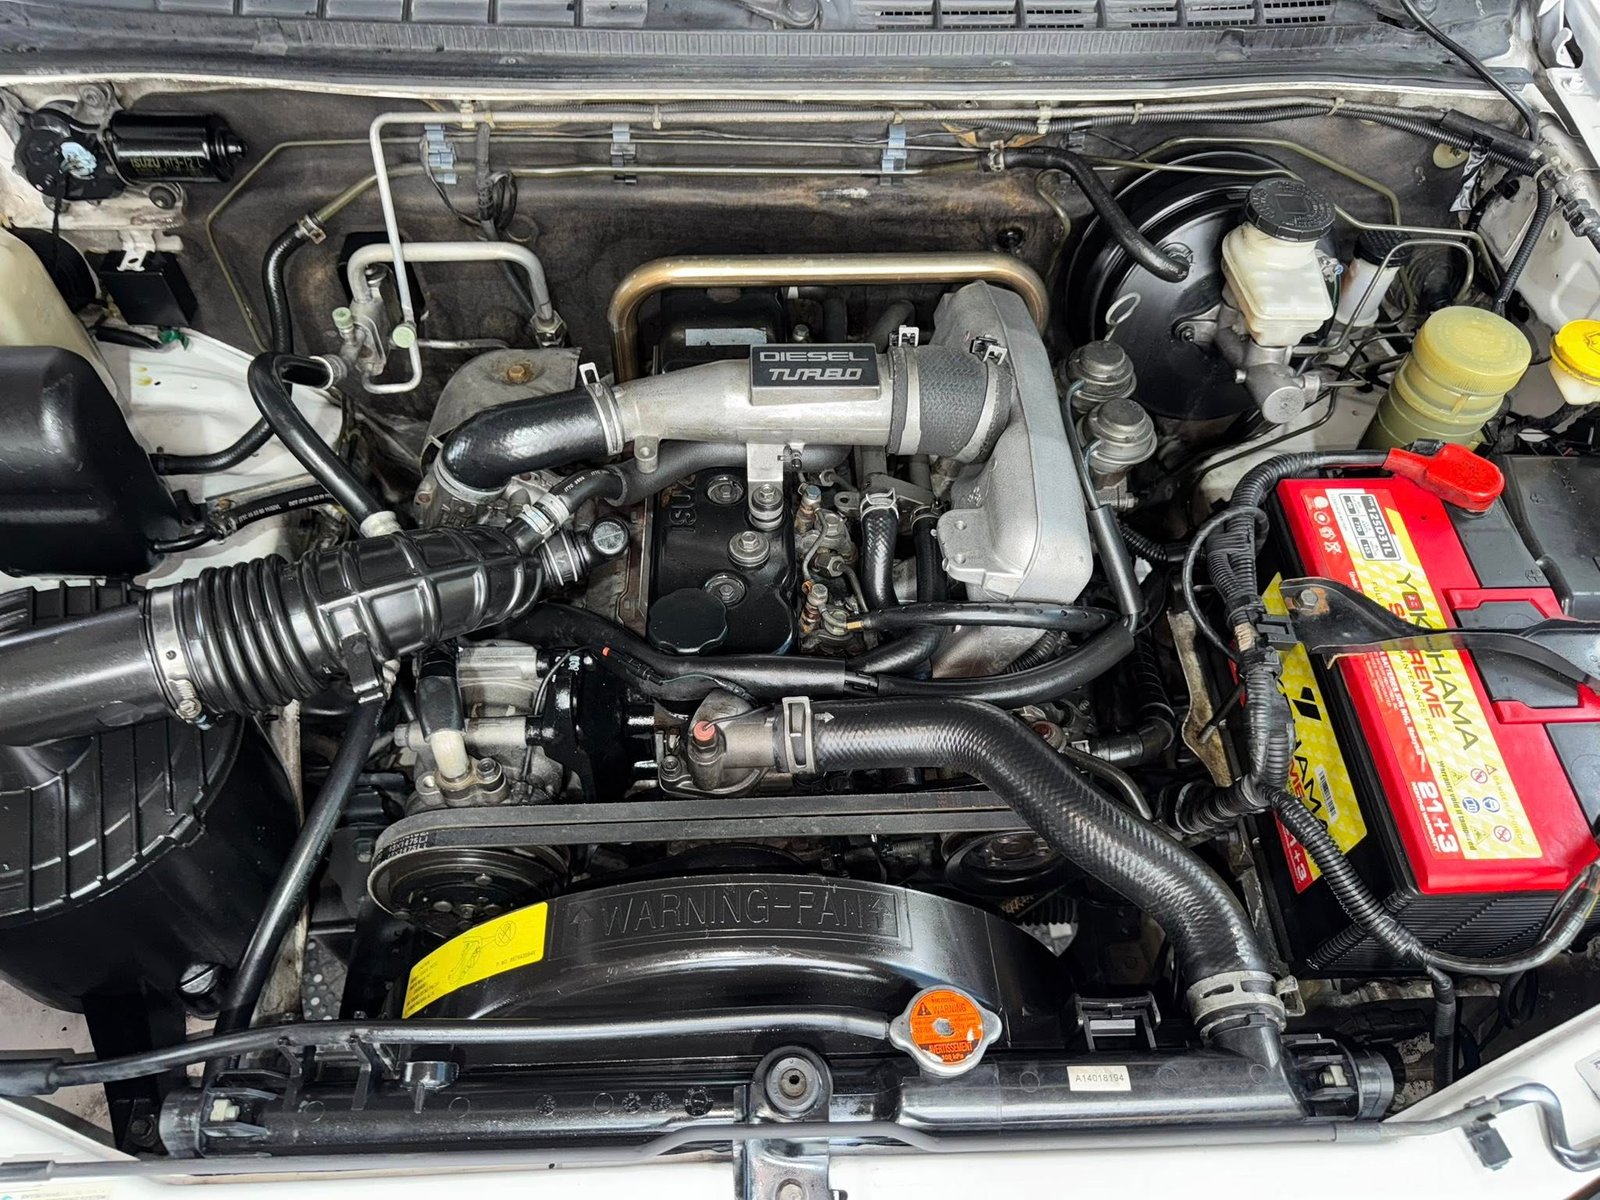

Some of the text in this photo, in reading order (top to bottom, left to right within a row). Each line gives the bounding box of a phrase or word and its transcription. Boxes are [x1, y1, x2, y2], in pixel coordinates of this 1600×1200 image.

[760, 351, 869, 362] DIESEL
[769, 368, 863, 381] TURBO
[1368, 507, 1392, 555] 125D31L
[1396, 571, 1479, 751] YOKHAMA
[1424, 717, 1438, 743] FREE
[1416, 781, 1460, 853] 21+3
[1421, 811, 1441, 852] WARRANTY
[932, 1003, 968, 1015] WARNING
